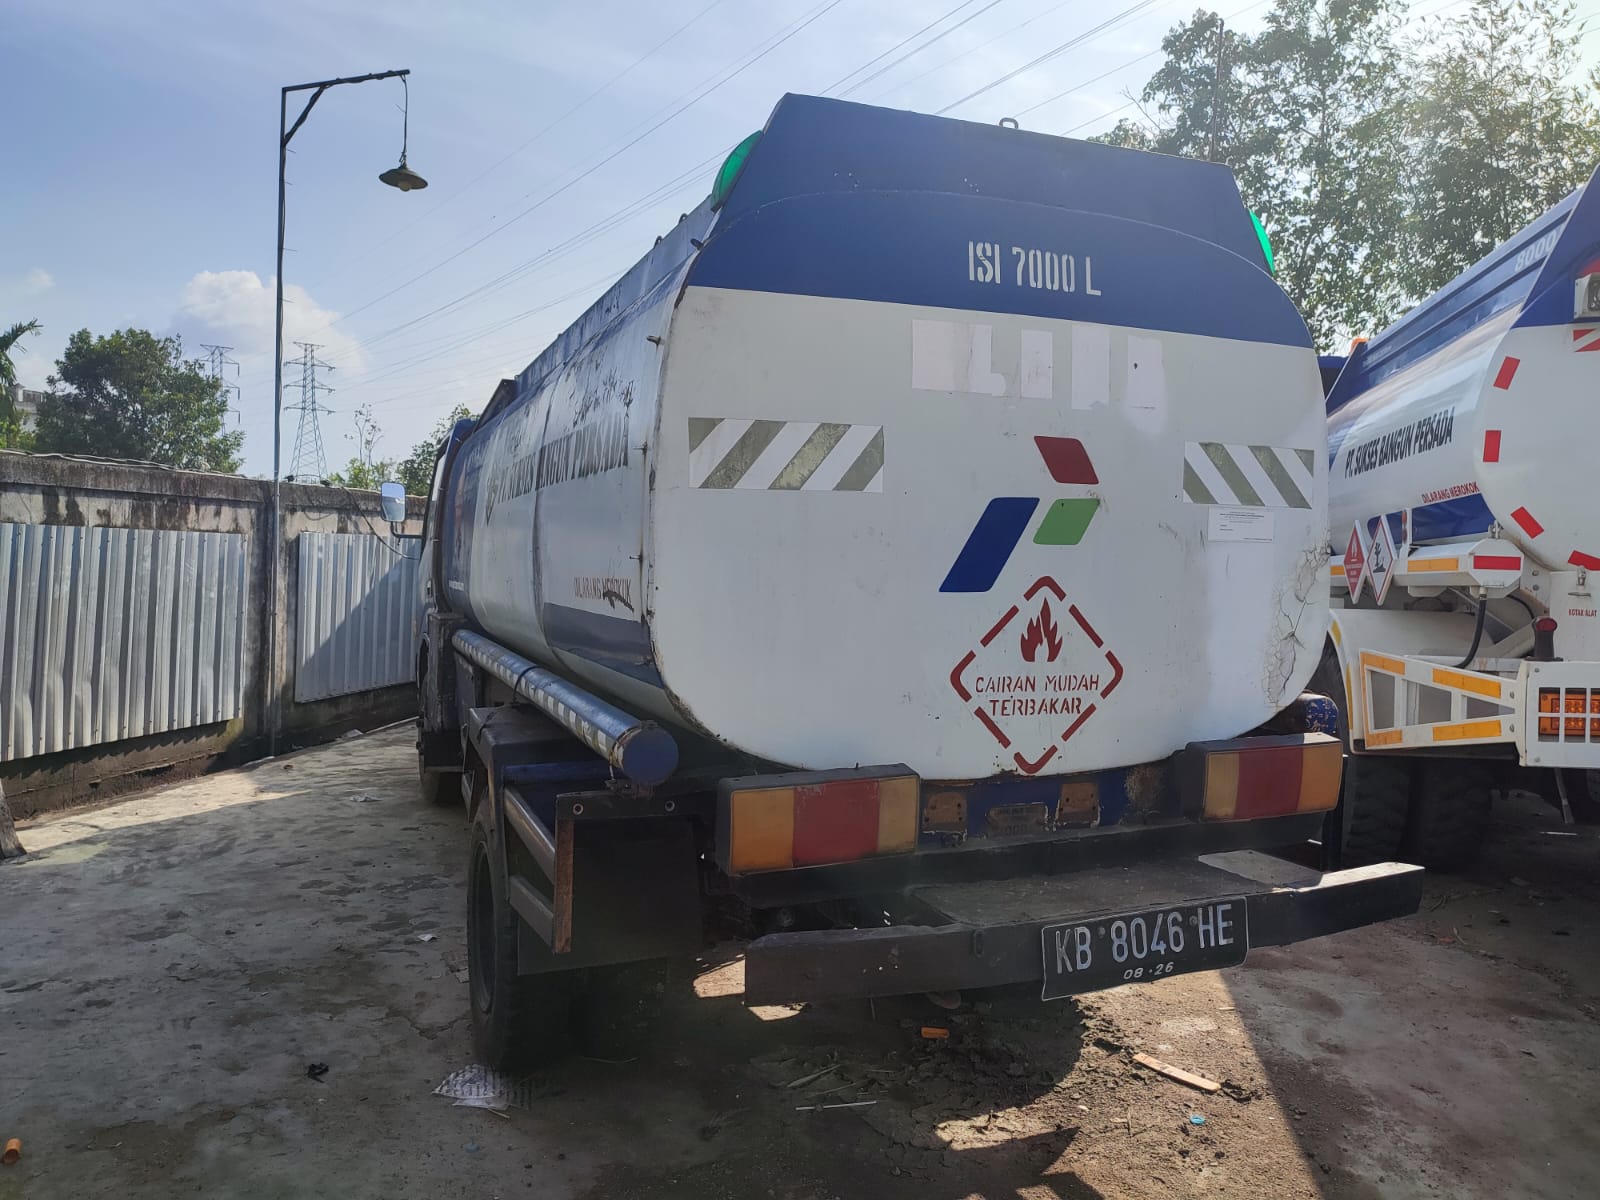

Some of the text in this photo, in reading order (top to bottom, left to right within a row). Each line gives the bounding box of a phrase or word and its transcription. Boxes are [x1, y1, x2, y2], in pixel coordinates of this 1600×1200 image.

[968, 240, 1102, 297] ISI 7000 L
[1513, 229, 1558, 272] 8000
[1354, 437, 1381, 476] SUKSES
[1378, 422, 1415, 467] BANGUN
[1413, 406, 1455, 455] PERSADA
[1421, 481, 1480, 504] DILARANG MEROKOK
[975, 673, 1100, 694] CAIRAN MUDAH
[989, 696, 1083, 717] TERBAKAR
[1055, 903, 1234, 975] KB 8046 HE
